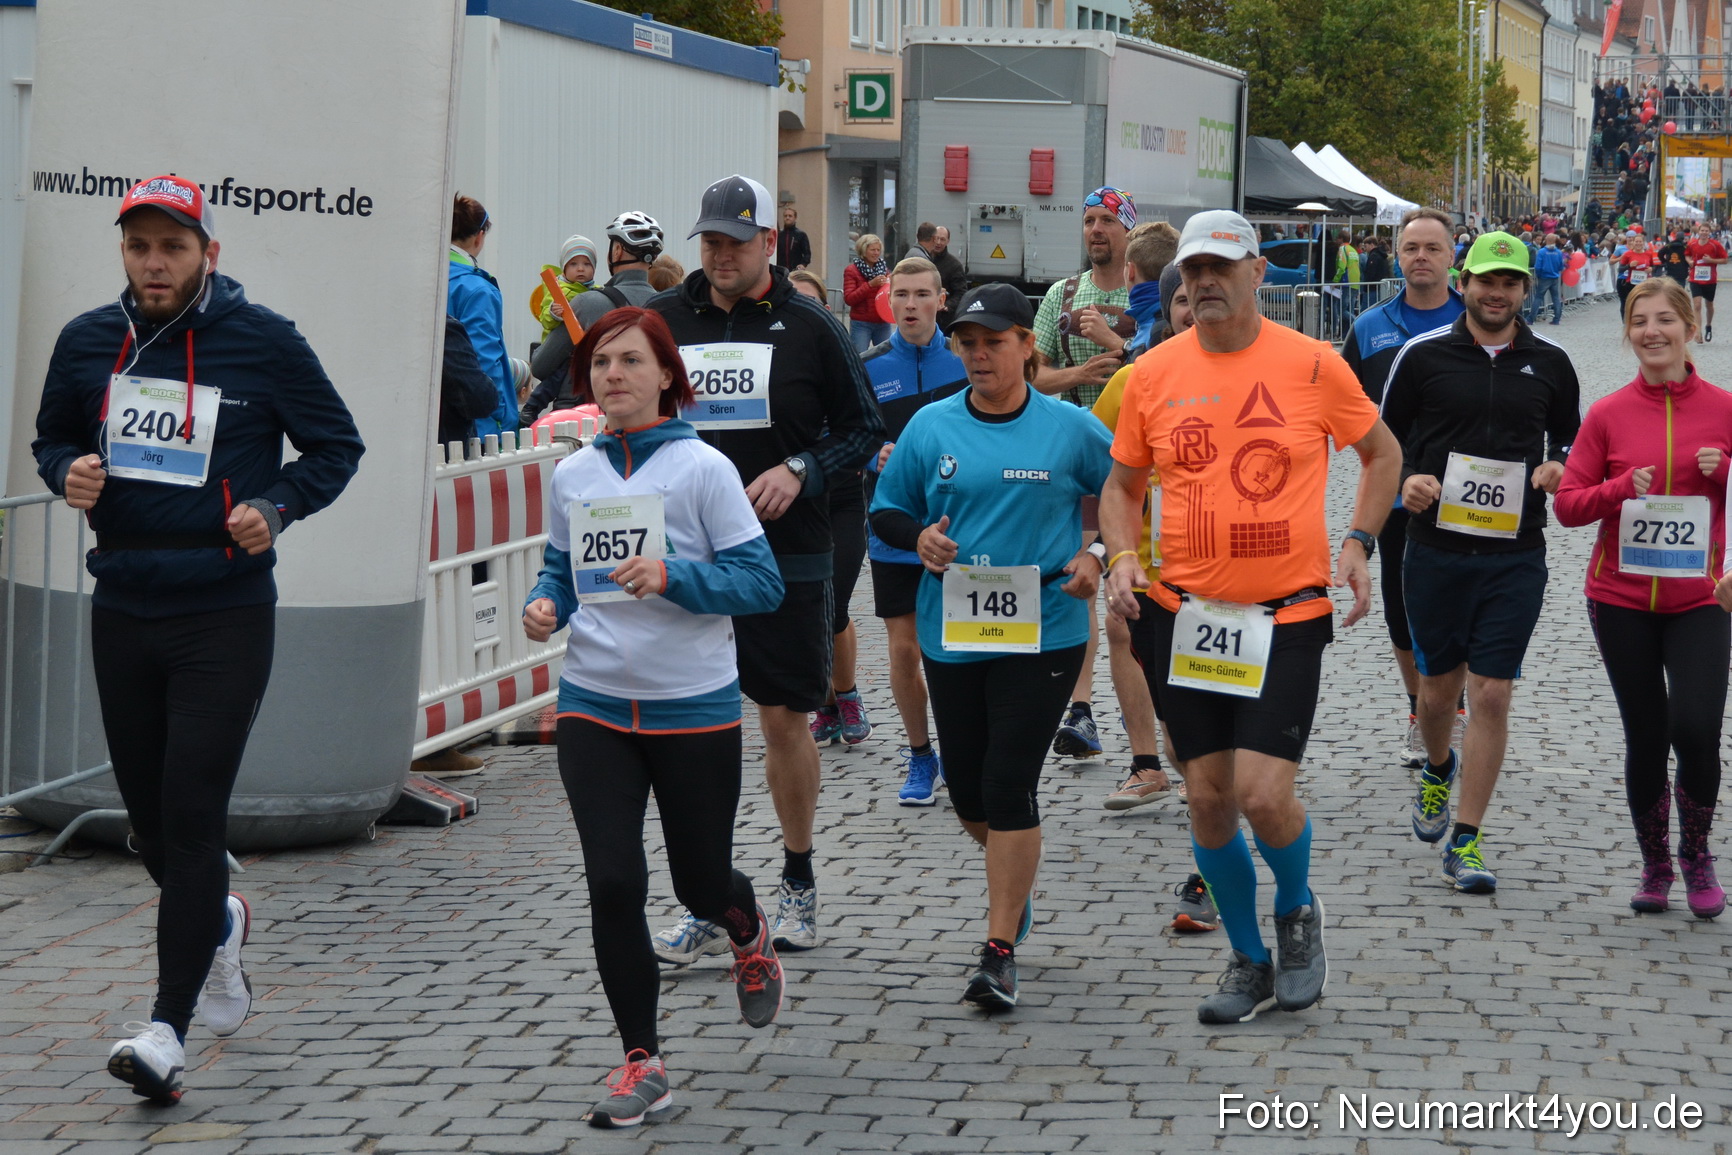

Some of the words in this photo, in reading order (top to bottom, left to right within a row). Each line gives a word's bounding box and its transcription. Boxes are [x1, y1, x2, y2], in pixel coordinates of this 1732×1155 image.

[855, 80, 886, 112] D
[1141, 124, 1166, 152] INDUSTRY
[1167, 128, 1187, 155] LOUNGE
[1198, 119, 1234, 180] BOCK
[160, 179, 194, 204] Monkey
[1211, 231, 1240, 243] OBI
[712, 350, 744, 358] BOCK
[689, 368, 754, 395] 2658
[1310, 359, 1320, 384] Reebok
[151, 387, 187, 400] BOCK
[709, 404, 735, 414] Sören
[121, 407, 196, 445] 2404
[141, 450, 164, 465] Jörg
[1003, 468, 1050, 481] BOCK
[1460, 480, 1505, 507] 266
[598, 506, 632, 517] BOCK
[1467, 512, 1493, 523] Marco
[1632, 519, 1695, 545] 2732
[582, 528, 648, 563] 2657
[1633, 549, 1679, 567] HEIDI
[967, 591, 1018, 617] 148
[979, 627, 1004, 636] Jutta
[1195, 624, 1242, 657] 241
[1189, 660, 1247, 678] Hans-Günter
